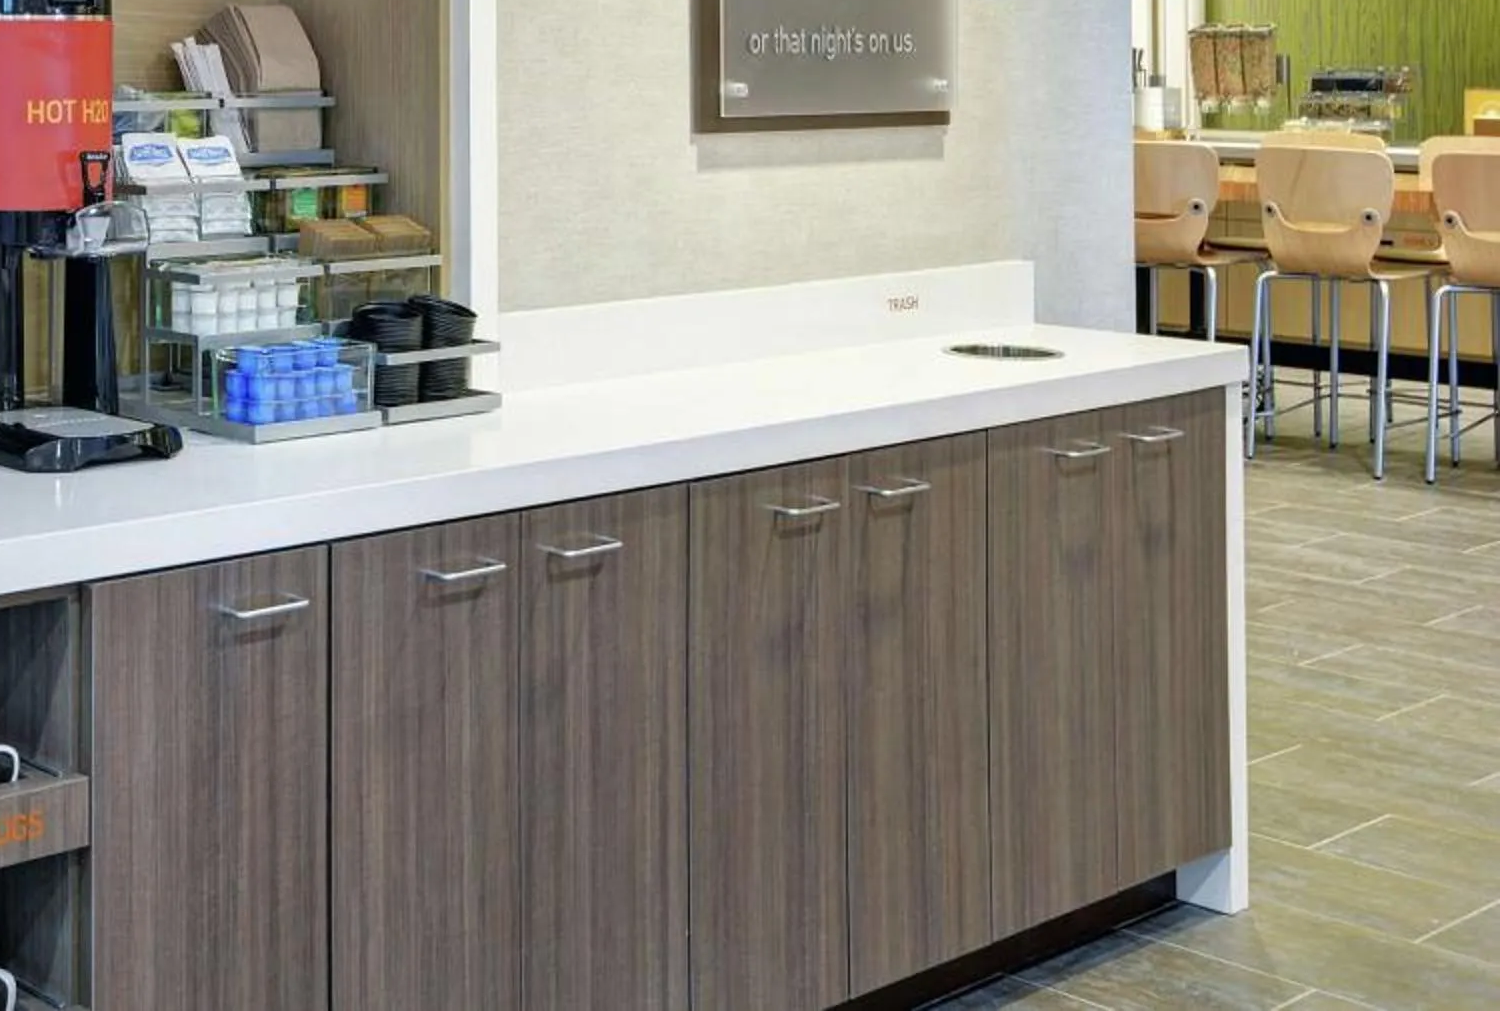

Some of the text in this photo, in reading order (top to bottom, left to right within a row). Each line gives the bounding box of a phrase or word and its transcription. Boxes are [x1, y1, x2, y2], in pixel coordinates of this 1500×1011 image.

[750, 24, 918, 61] or that night's on us.
[26, 99, 77, 124] HOT
[886, 294, 919, 312] TRASH
